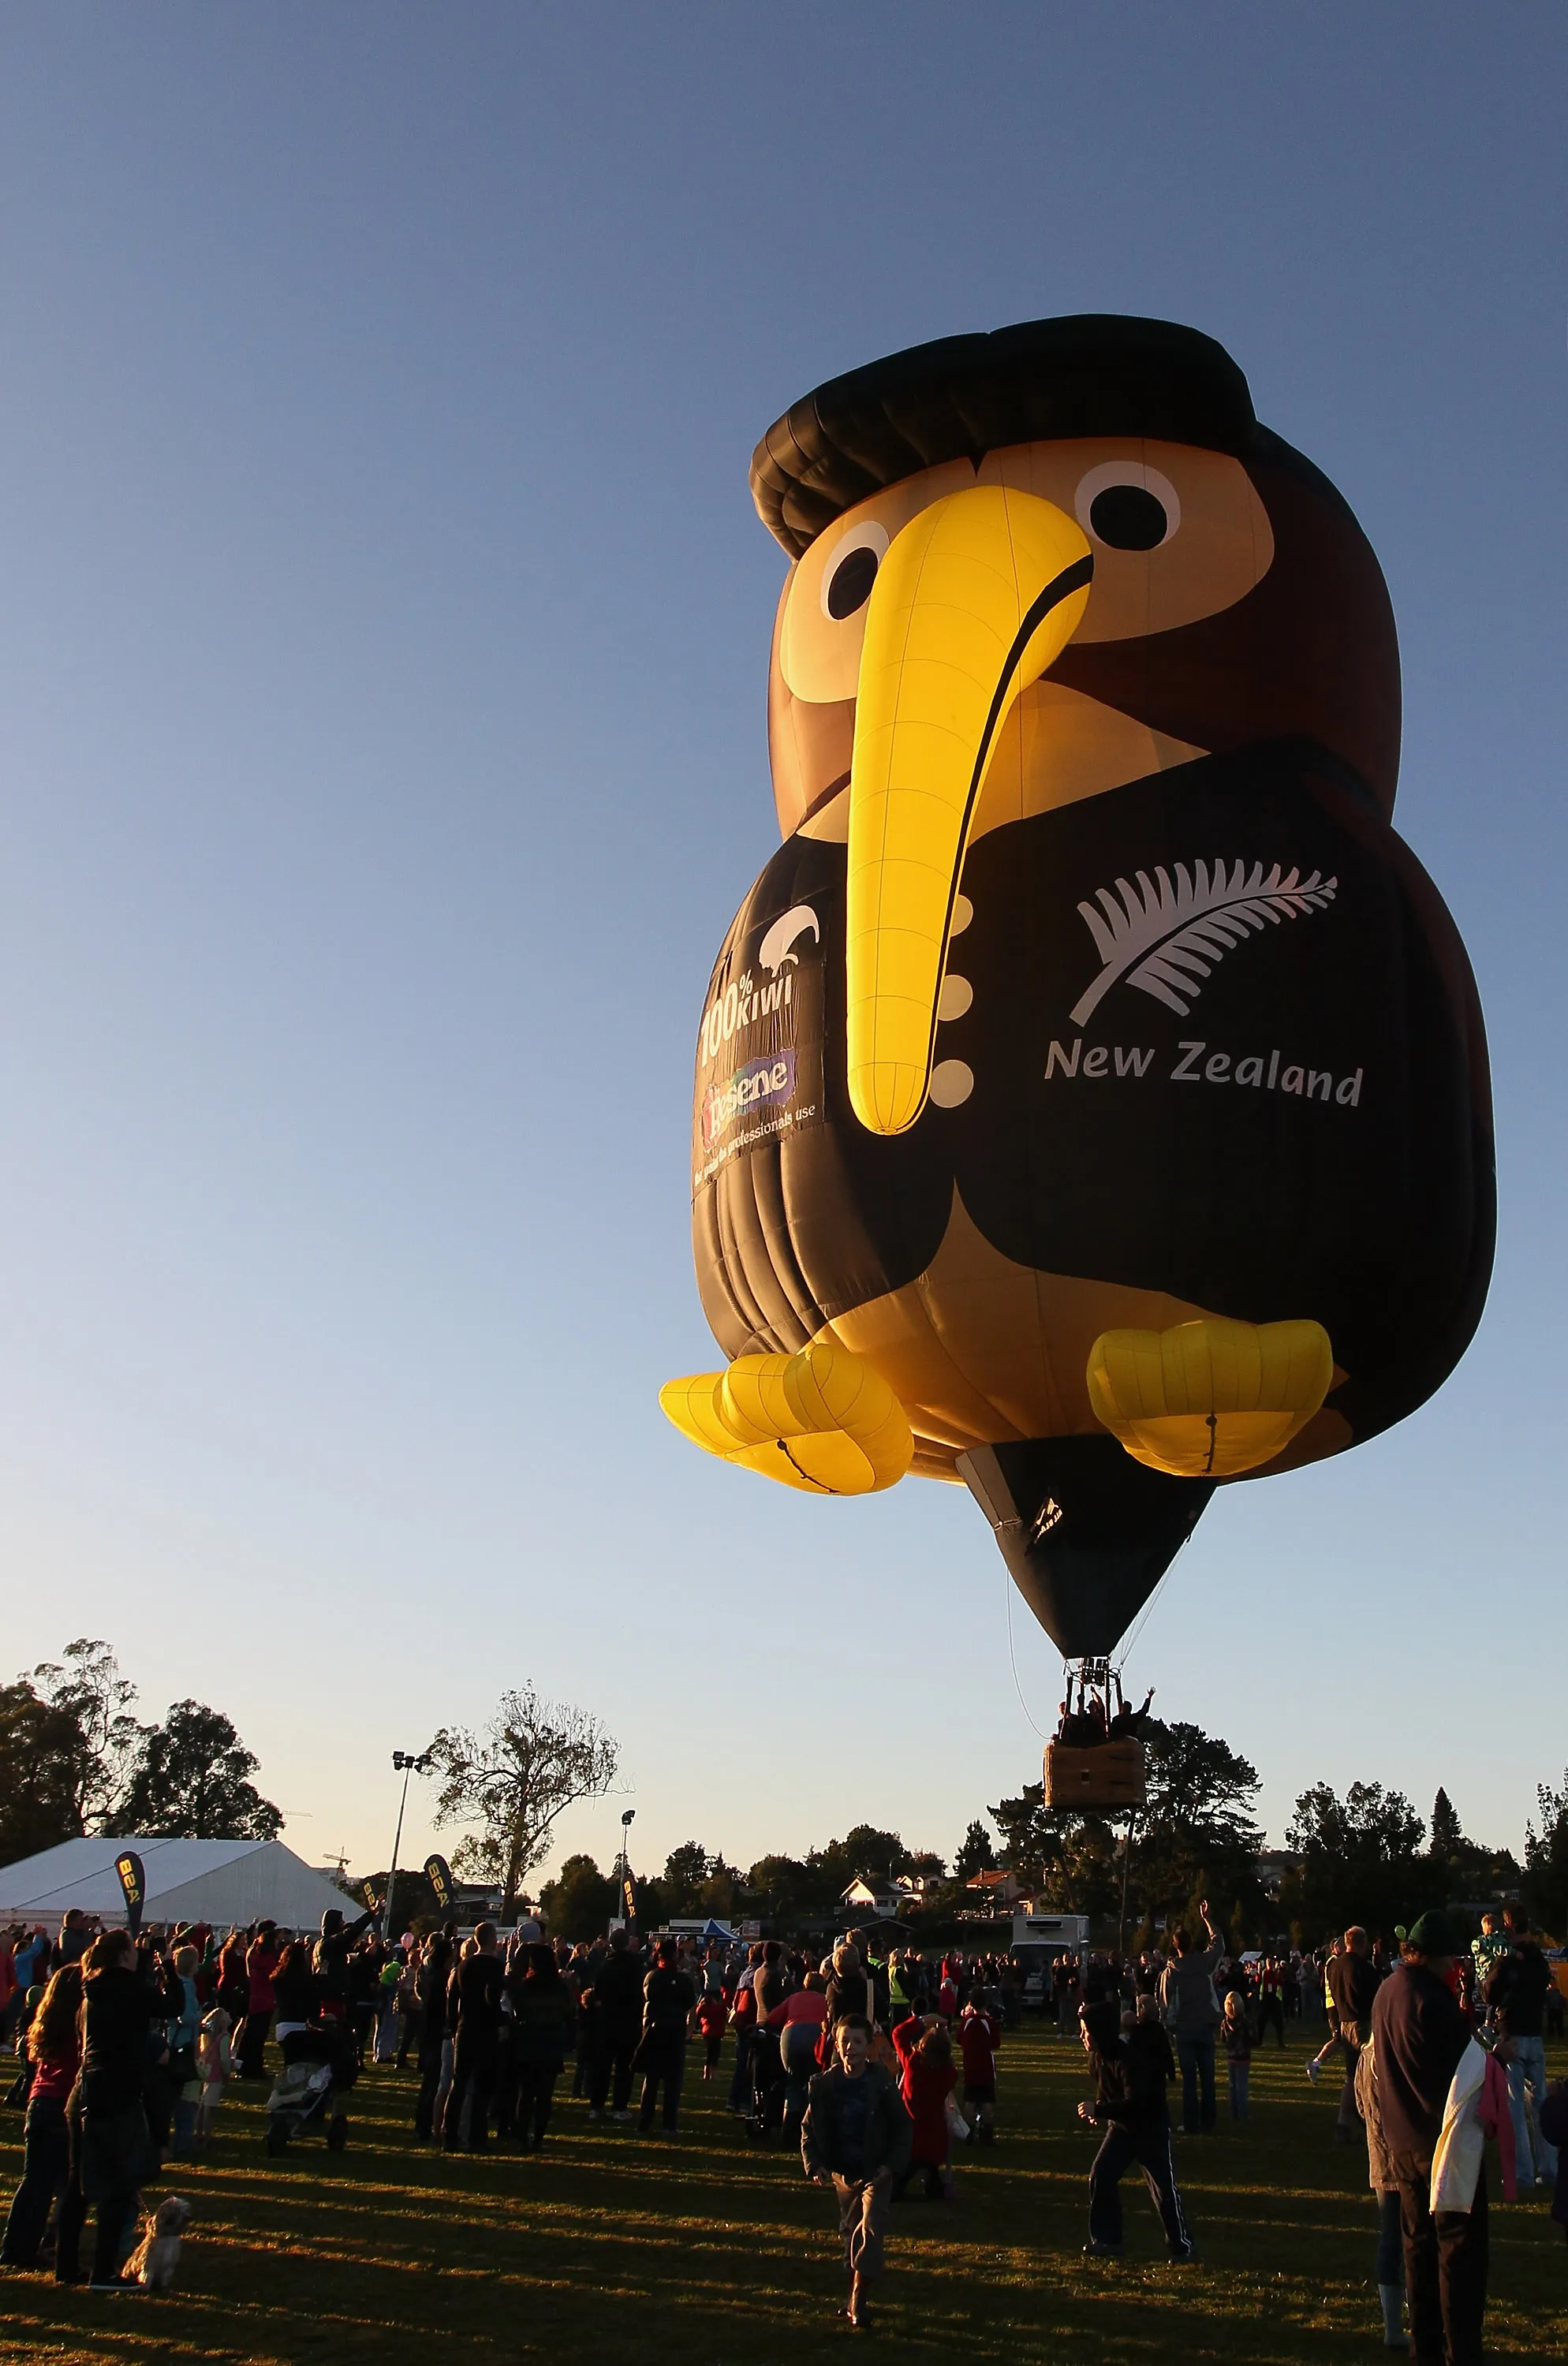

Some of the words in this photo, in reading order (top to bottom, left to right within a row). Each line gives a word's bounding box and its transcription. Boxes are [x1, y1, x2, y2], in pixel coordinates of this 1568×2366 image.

[700, 968, 753, 1068] 100%
[737, 973, 792, 1031] KIWI
[1044, 1038, 1155, 1080] New
[1170, 1041, 1364, 1107] Zealand
[728, 1110, 793, 1157] professionals
[795, 1104, 816, 1121] use
